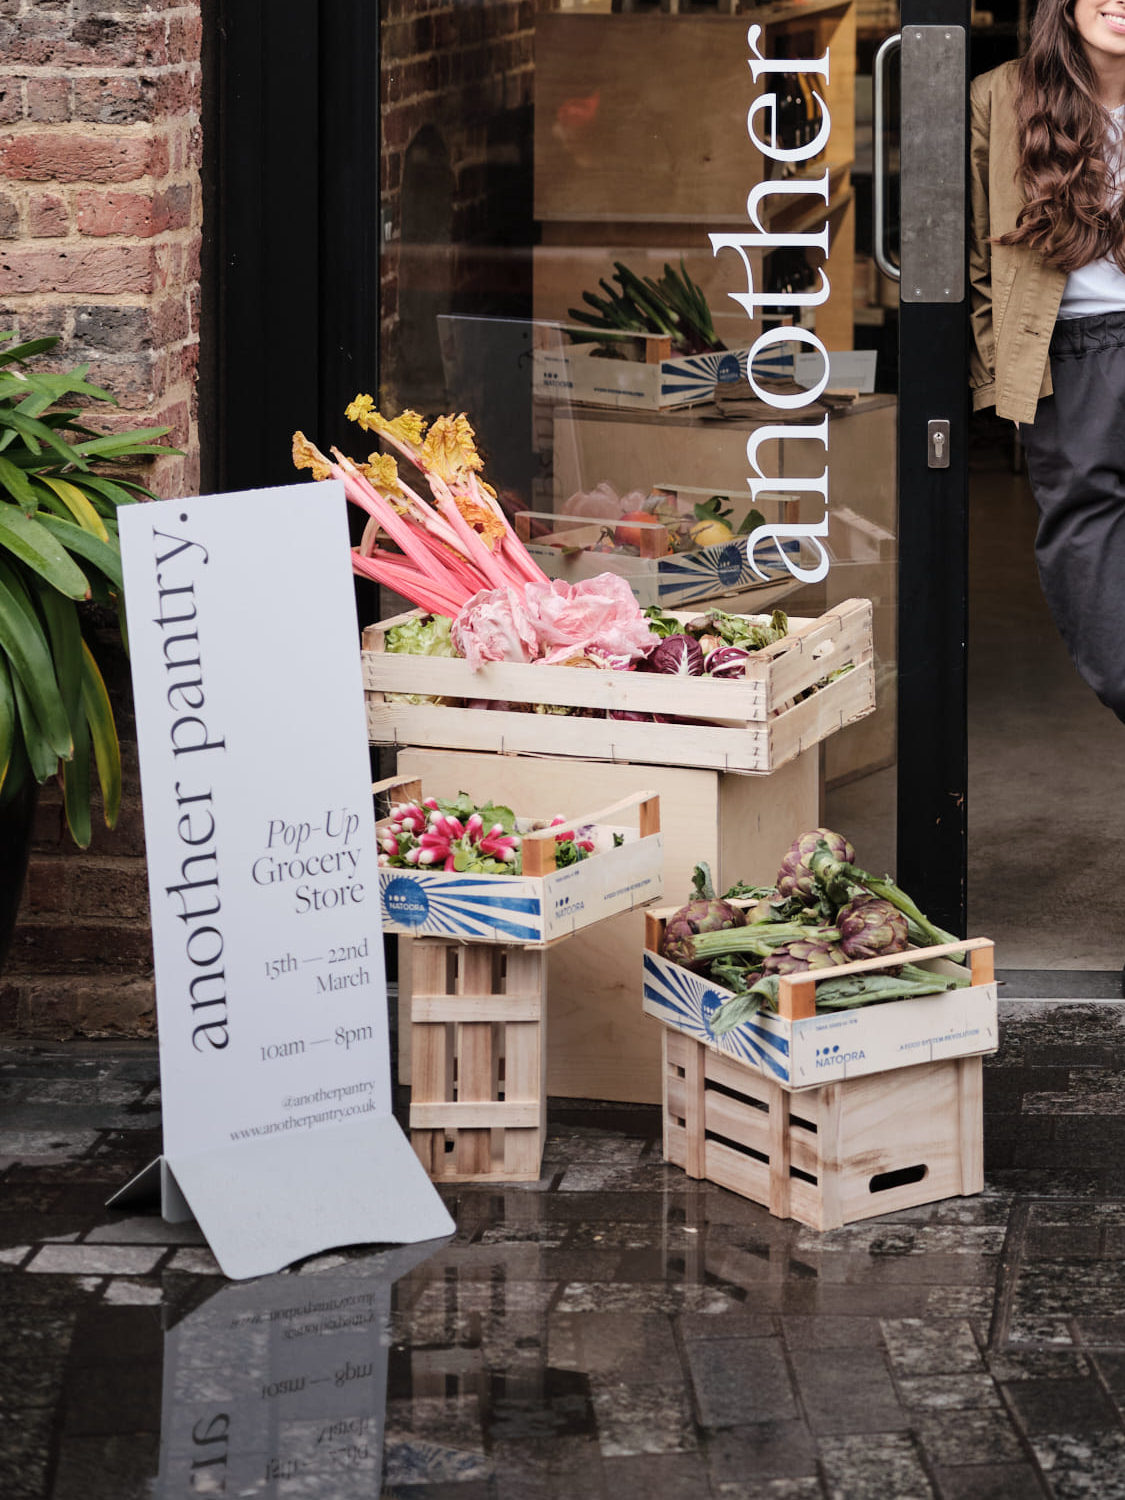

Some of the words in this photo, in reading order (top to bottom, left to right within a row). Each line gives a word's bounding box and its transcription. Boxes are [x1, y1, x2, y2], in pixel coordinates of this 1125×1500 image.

[708, 24, 831, 583] another
[152, 512, 226, 760] pantry.
[265, 807, 360, 853] Pop-Up
[252, 846, 363, 888] Grocery
[165, 781, 229, 1053] another
[295, 880, 365, 915] Store
[264, 952, 298, 980] 15th
[328, 938, 369, 965] 22nd
[315, 967, 370, 995] March
[260, 1038, 305, 1062] 10am
[334, 1024, 374, 1051] 8pm
[815, 1049, 866, 1068] NATOORA
